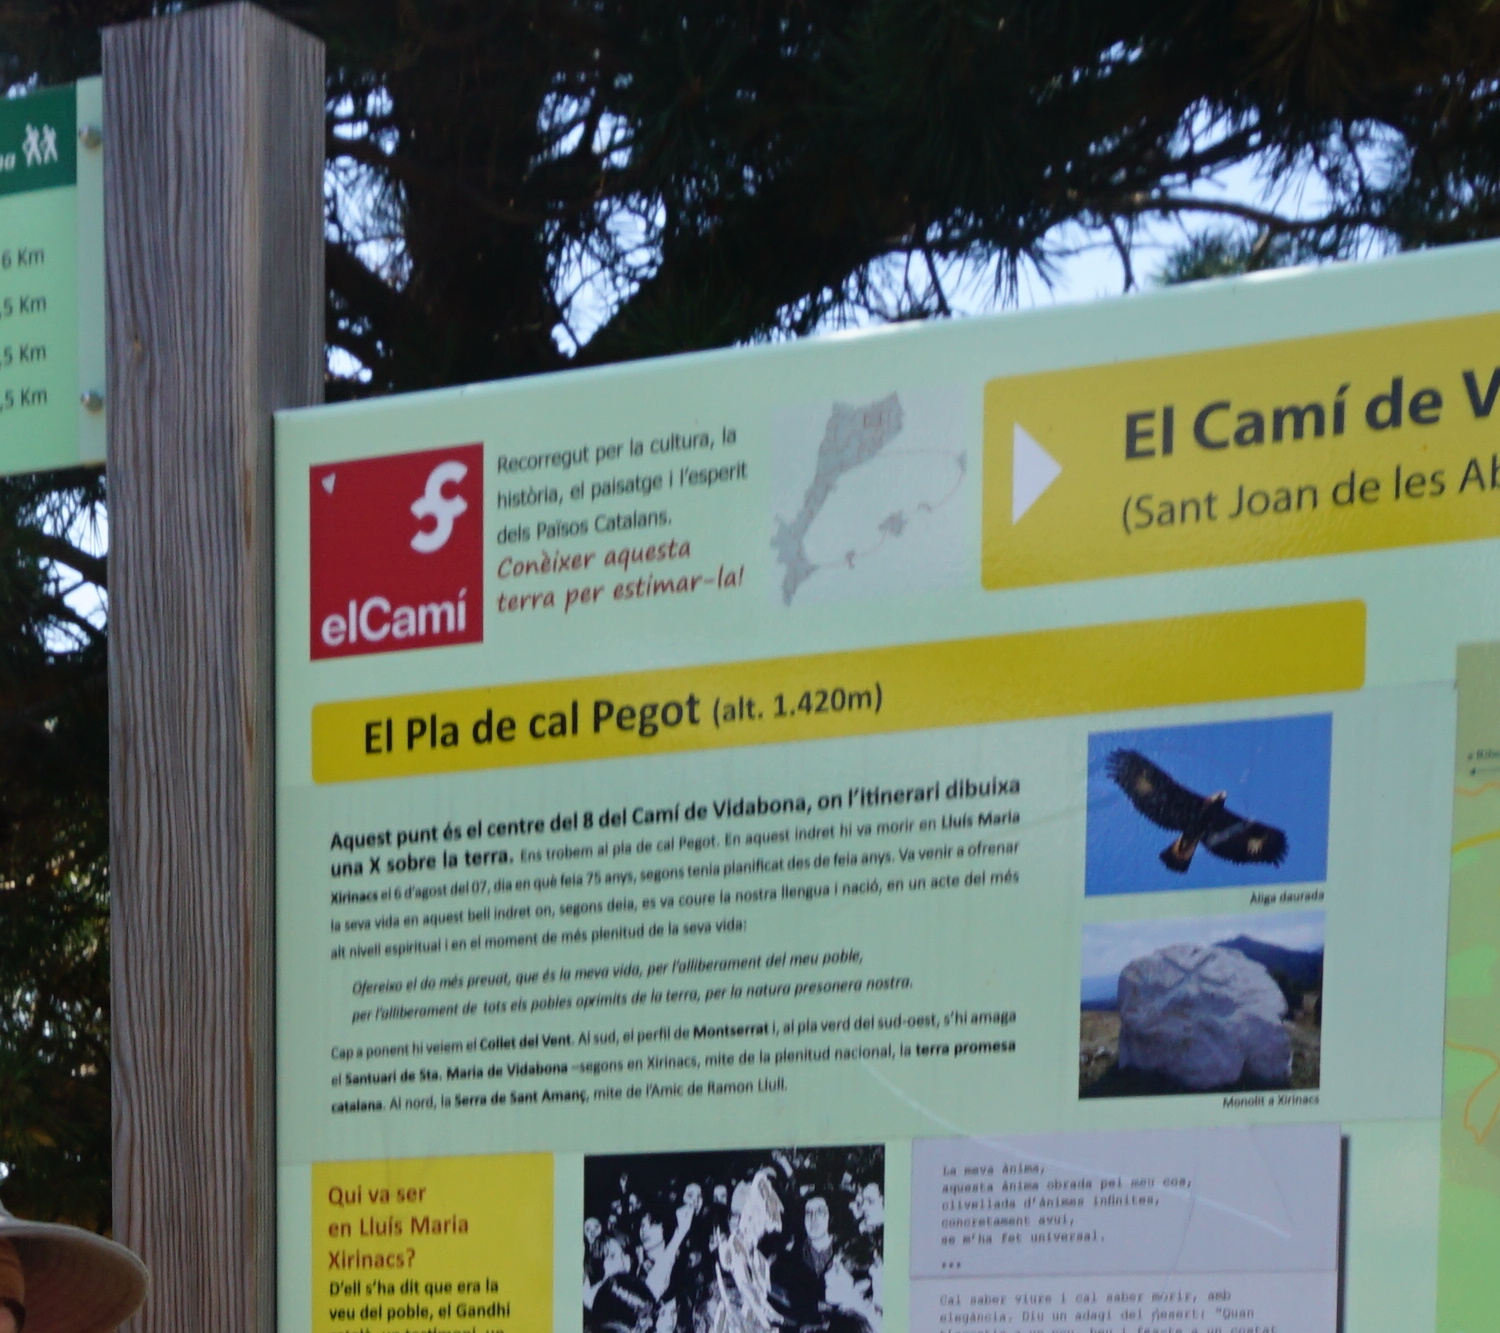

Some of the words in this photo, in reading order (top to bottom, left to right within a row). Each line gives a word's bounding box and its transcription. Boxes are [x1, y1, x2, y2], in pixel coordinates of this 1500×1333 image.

[0, 250, 12, 270] 6
[17, 248, 45, 267] Km
[19, 295, 47, 314] Km
[18, 344, 47, 363] Km
[19, 387, 48, 407] Km
[1124, 405, 1174, 460] El
[1192, 384, 1350, 450] Camí
[1364, 376, 1443, 431] de
[497, 446, 589, 473] Recorregut
[595, 443, 623, 465] per
[629, 437, 644, 457] la
[649, 432, 715, 454] cultura,
[721, 425, 737, 445] la
[496, 486, 563, 509] història,
[569, 480, 585, 500] el
[590, 475, 663, 501] paisatge
[1121, 492, 1217, 534] (Sant
[1227, 485, 1319, 519] Joan
[1331, 470, 1381, 507] de
[1393, 464, 1446, 501] les
[496, 524, 531, 545] dels
[536, 520, 589, 539] Països
[593, 510, 672, 532] Catalans.
[496, 551, 596, 579] Conèixer
[603, 539, 691, 571] aquesta
[496, 591, 555, 613] terra
[563, 586, 605, 614] per
[612, 566, 745, 600] estimar-la!
[320, 589, 467, 645] elCamí
[364, 717, 393, 755] El
[406, 713, 459, 751] Pla
[471, 708, 517, 745] de
[528, 700, 579, 739] cal
[593, 694, 700, 738] Pegot
[712, 695, 763, 728] (alt.
[774, 683, 883, 717] 1.420m)
[329, 830, 392, 852] Aquest
[396, 825, 438, 849] punt
[442, 822, 462, 841] és
[465, 819, 483, 839] el
[486, 818, 545, 837] centre
[549, 811, 578, 832] del
[582, 811, 594, 829] 8
[597, 807, 627, 828] del
[631, 803, 679, 825] Camí
[683, 801, 708, 821] de
[817, 794, 843, 810] on
[945, 777, 1021, 799] dibuixa
[327, 1185, 362, 1208] Qui
[367, 1188, 390, 1204] va
[396, 1187, 427, 1203] ser
[327, 1222, 352, 1238] en
[359, 1215, 403, 1237] Lluís
[410, 1214, 469, 1235] Maria
[328, 1247, 416, 1270] Xirinacs?
